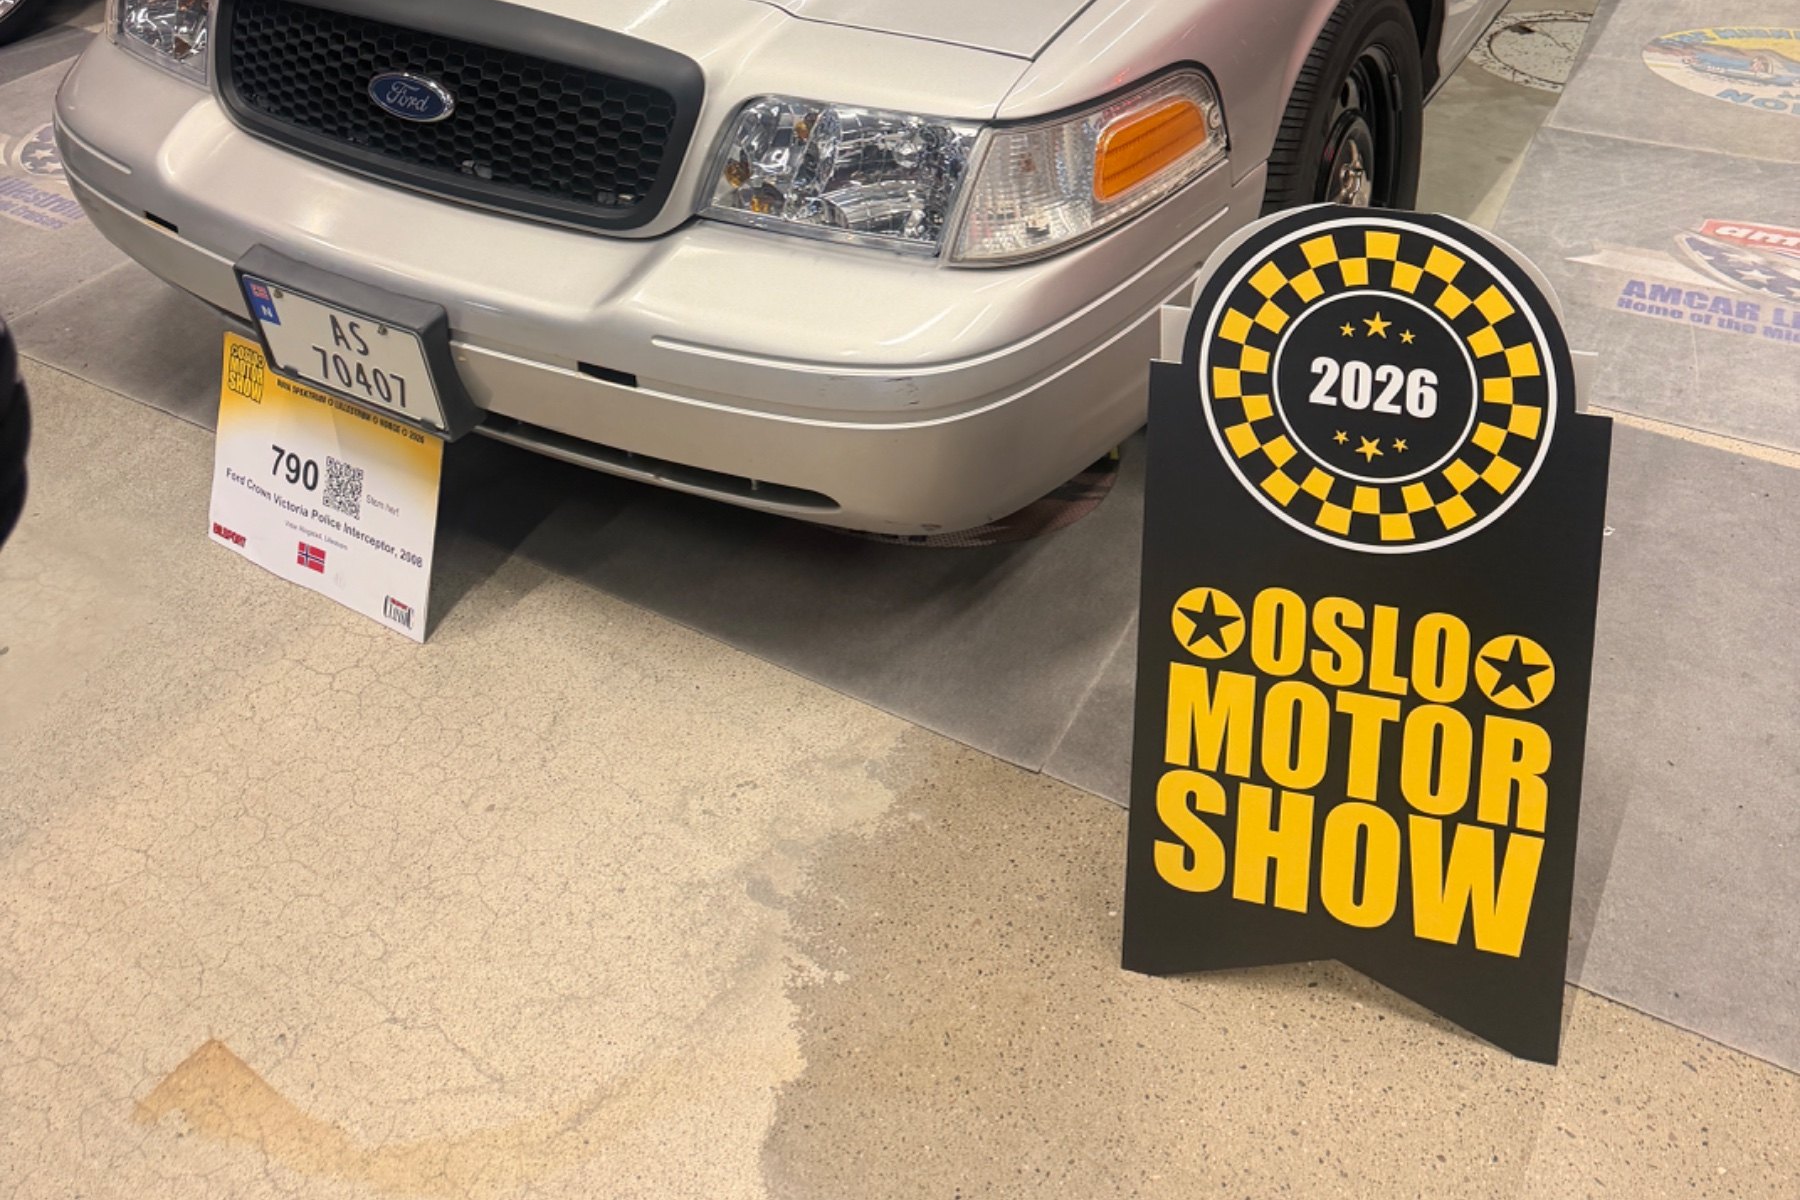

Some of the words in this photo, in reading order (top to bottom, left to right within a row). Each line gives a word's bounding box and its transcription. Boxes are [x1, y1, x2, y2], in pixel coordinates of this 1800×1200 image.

[386, 81, 430, 112] Ford
[261, 304, 273, 318] N
[1617, 297, 1684, 319] Home
[1690, 313, 1713, 325] of
[1717, 318, 1757, 334] the
[1622, 280, 1761, 322] AMCAR
[329, 314, 369, 356] AS
[228, 371, 262, 404] SHOW
[229, 356, 264, 385] MOTOR
[312, 345, 406, 408] 70407
[1308, 355, 1439, 421] 2026
[272, 444, 319, 491] 790
[226, 467, 245, 486] Ford
[247, 478, 272, 501] Crown
[273, 491, 309, 518] Victoria
[311, 509, 342, 531] Police
[343, 523, 398, 558] Interceptor,
[400, 548, 424, 568] 2008
[1251, 586, 1471, 705] OSLO
[1164, 662, 1552, 833] MOTOR
[1153, 769, 1546, 959] SHOW
